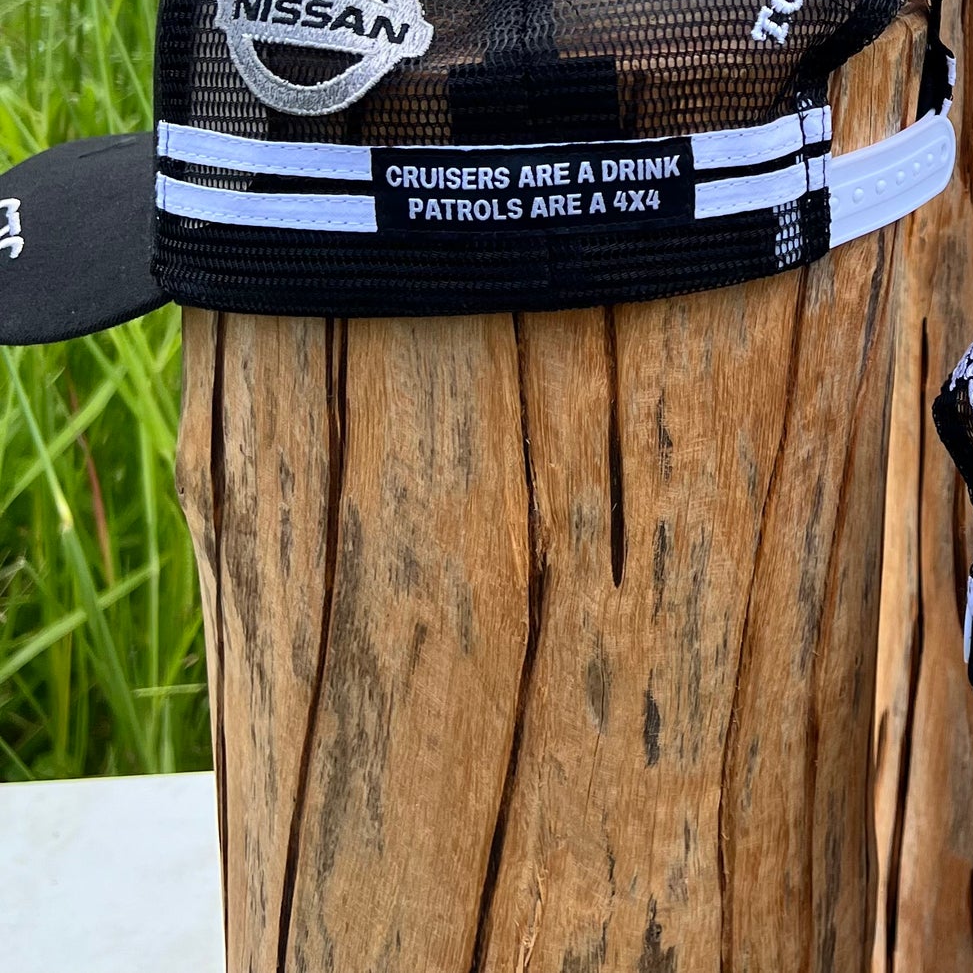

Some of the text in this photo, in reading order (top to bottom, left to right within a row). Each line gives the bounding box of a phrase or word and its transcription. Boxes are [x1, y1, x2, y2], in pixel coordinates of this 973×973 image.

[385, 154, 681, 190] CRUISERS ARE A DRINK
[408, 189, 661, 221] PATROLS ARE A 4X4
